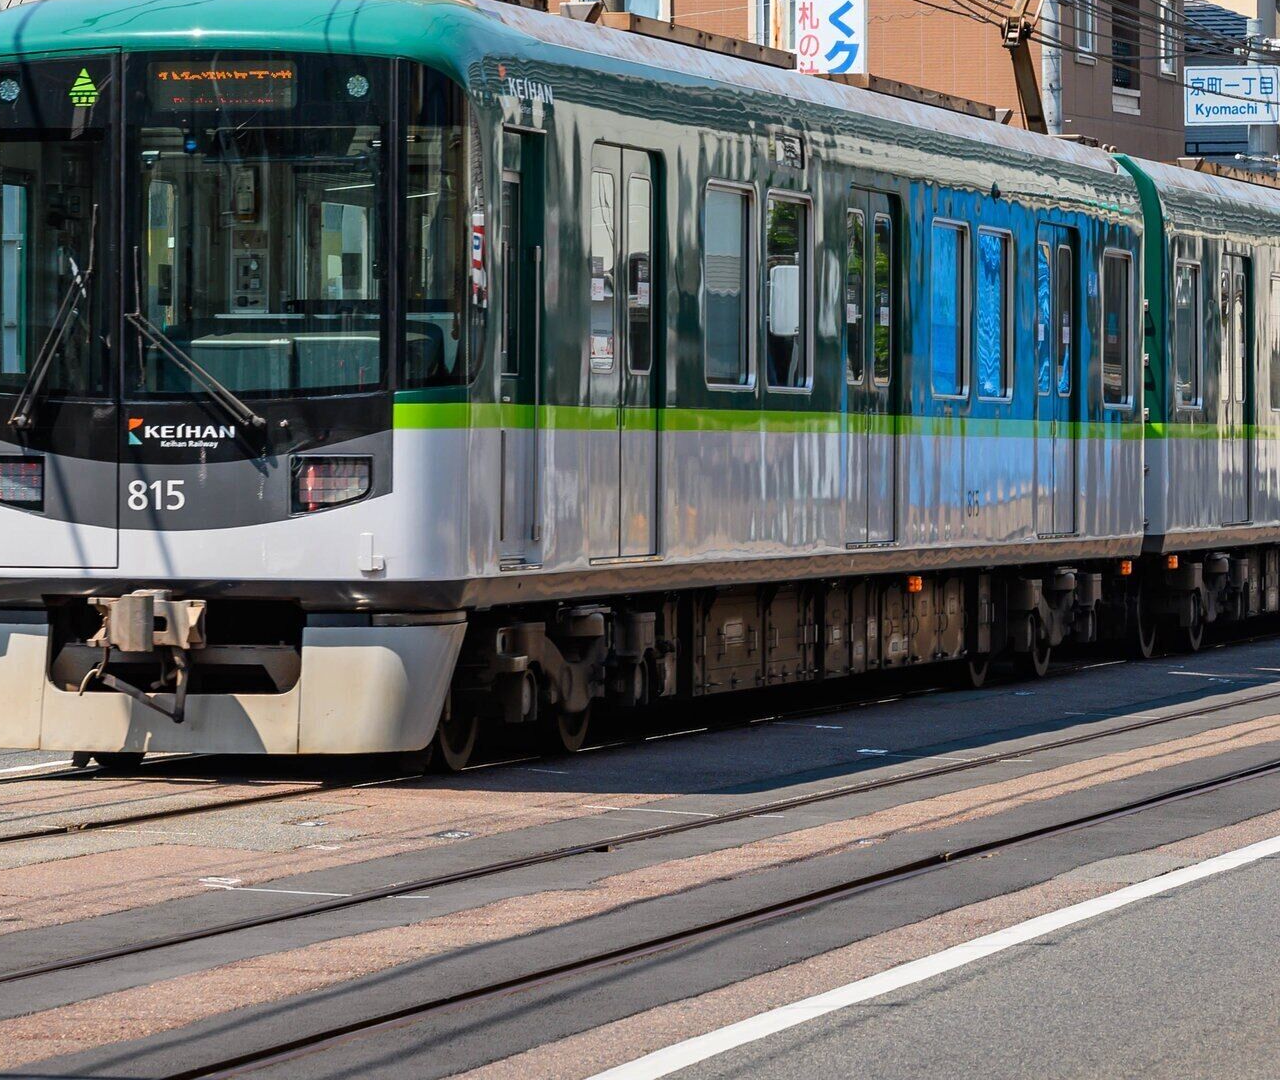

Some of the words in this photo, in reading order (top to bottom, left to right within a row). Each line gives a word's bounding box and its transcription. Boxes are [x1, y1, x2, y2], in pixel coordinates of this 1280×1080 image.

[508, 77, 554, 104] KEIHAN
[1190, 76, 1274, 96] 京町一丁目
[1195, 103, 1258, 117] Kyomachi
[1264, 102, 1270, 114] 1
[144, 423, 236, 439] KEIHAN
[160, 440, 187, 448] Keihan
[188, 440, 219, 449] Railway
[127, 479, 186, 511] 815
[967, 490, 980, 518] 815
